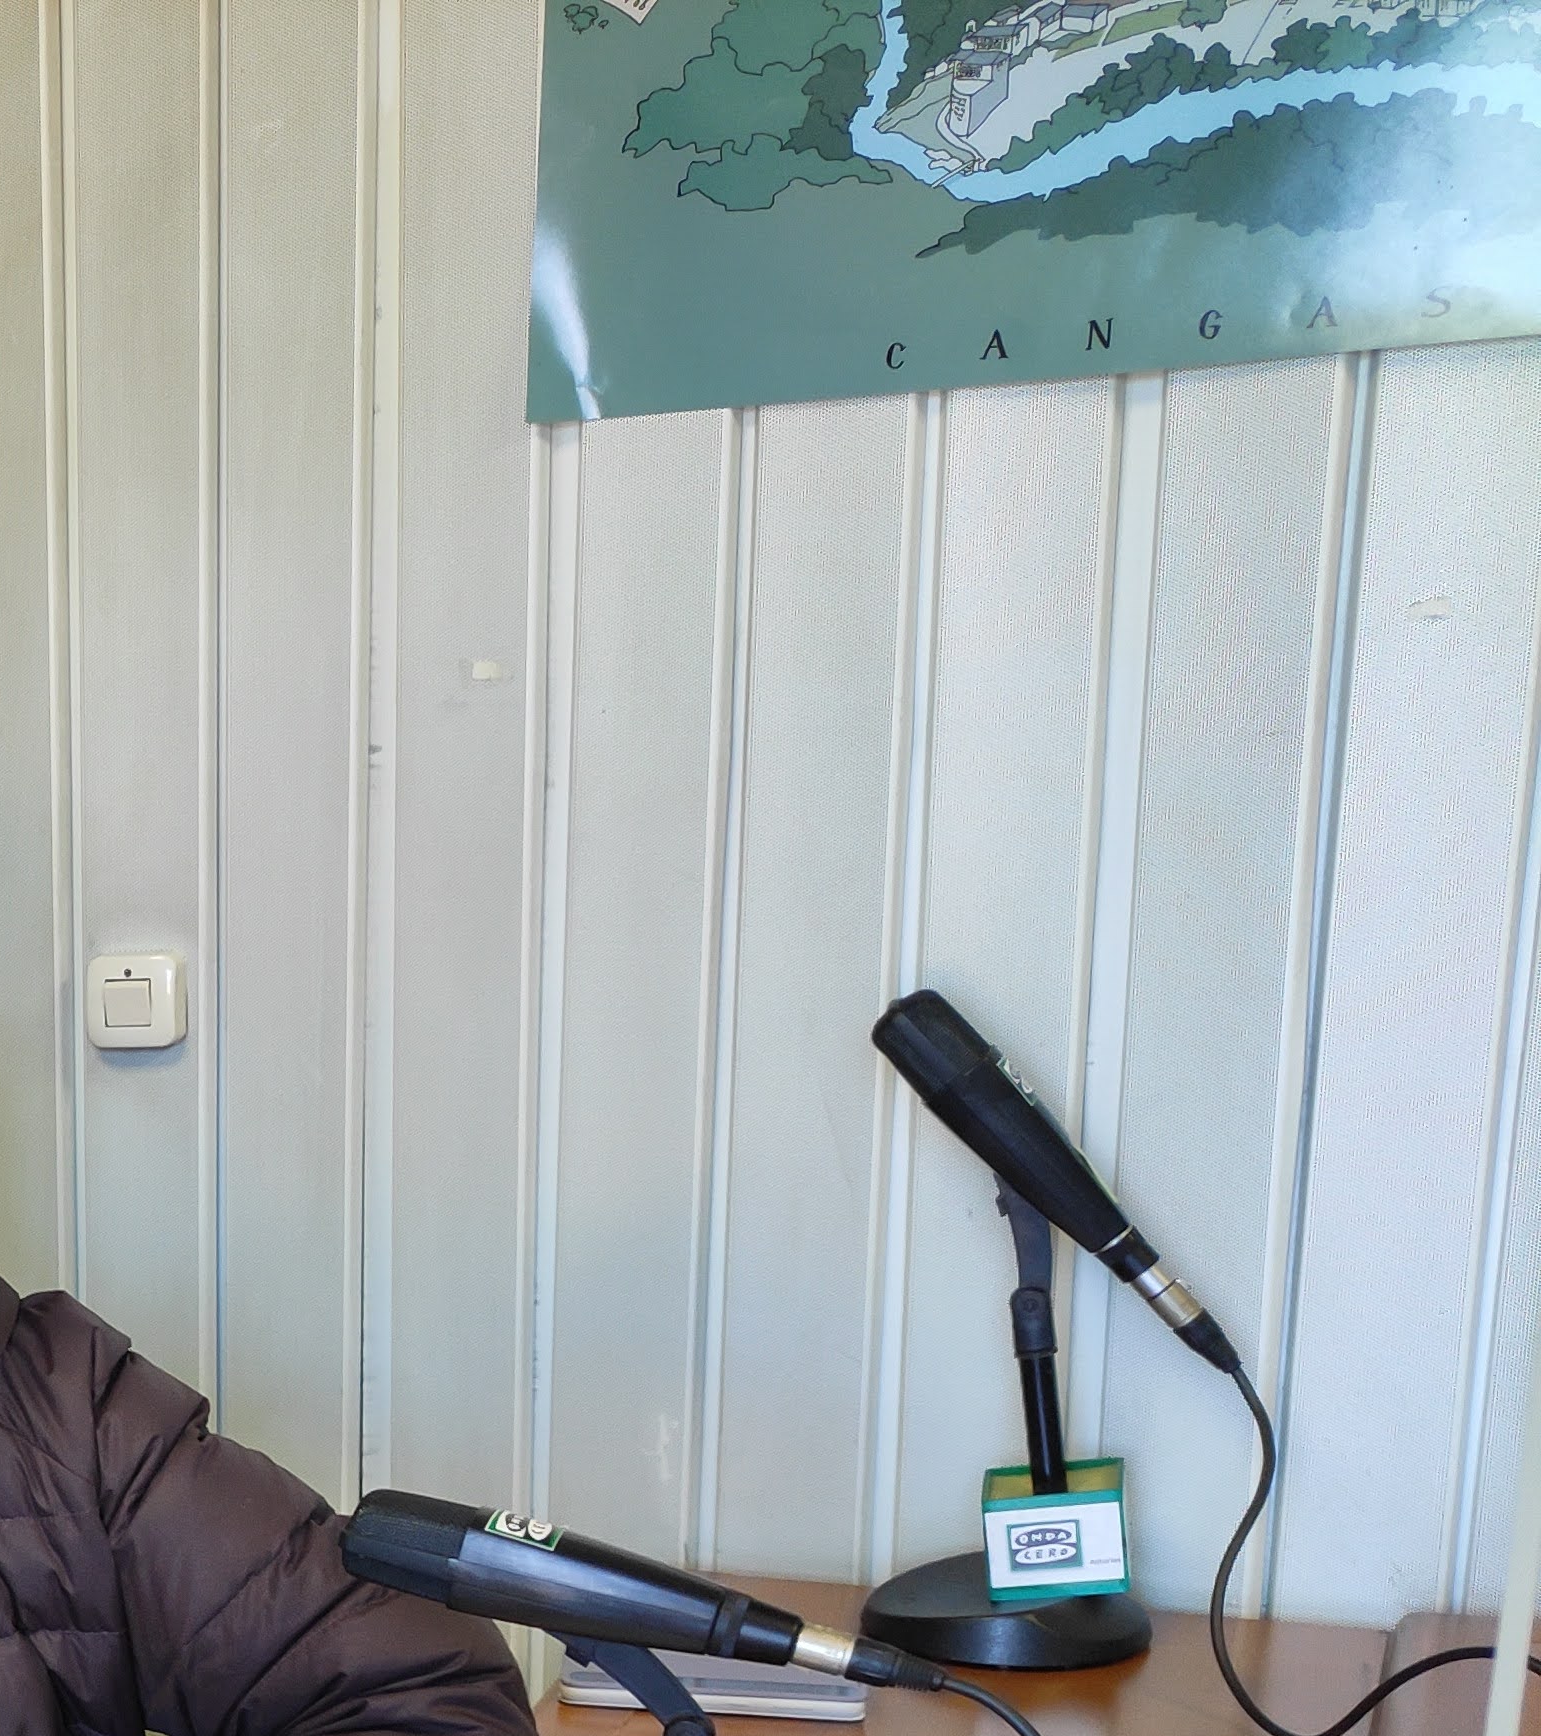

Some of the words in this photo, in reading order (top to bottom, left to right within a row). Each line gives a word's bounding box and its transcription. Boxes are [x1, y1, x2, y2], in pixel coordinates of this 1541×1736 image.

[884, 285, 1453, 371] CANGAS
[1019, 1531, 1068, 1543] ONDA
[1023, 1547, 1068, 1561] CERO
